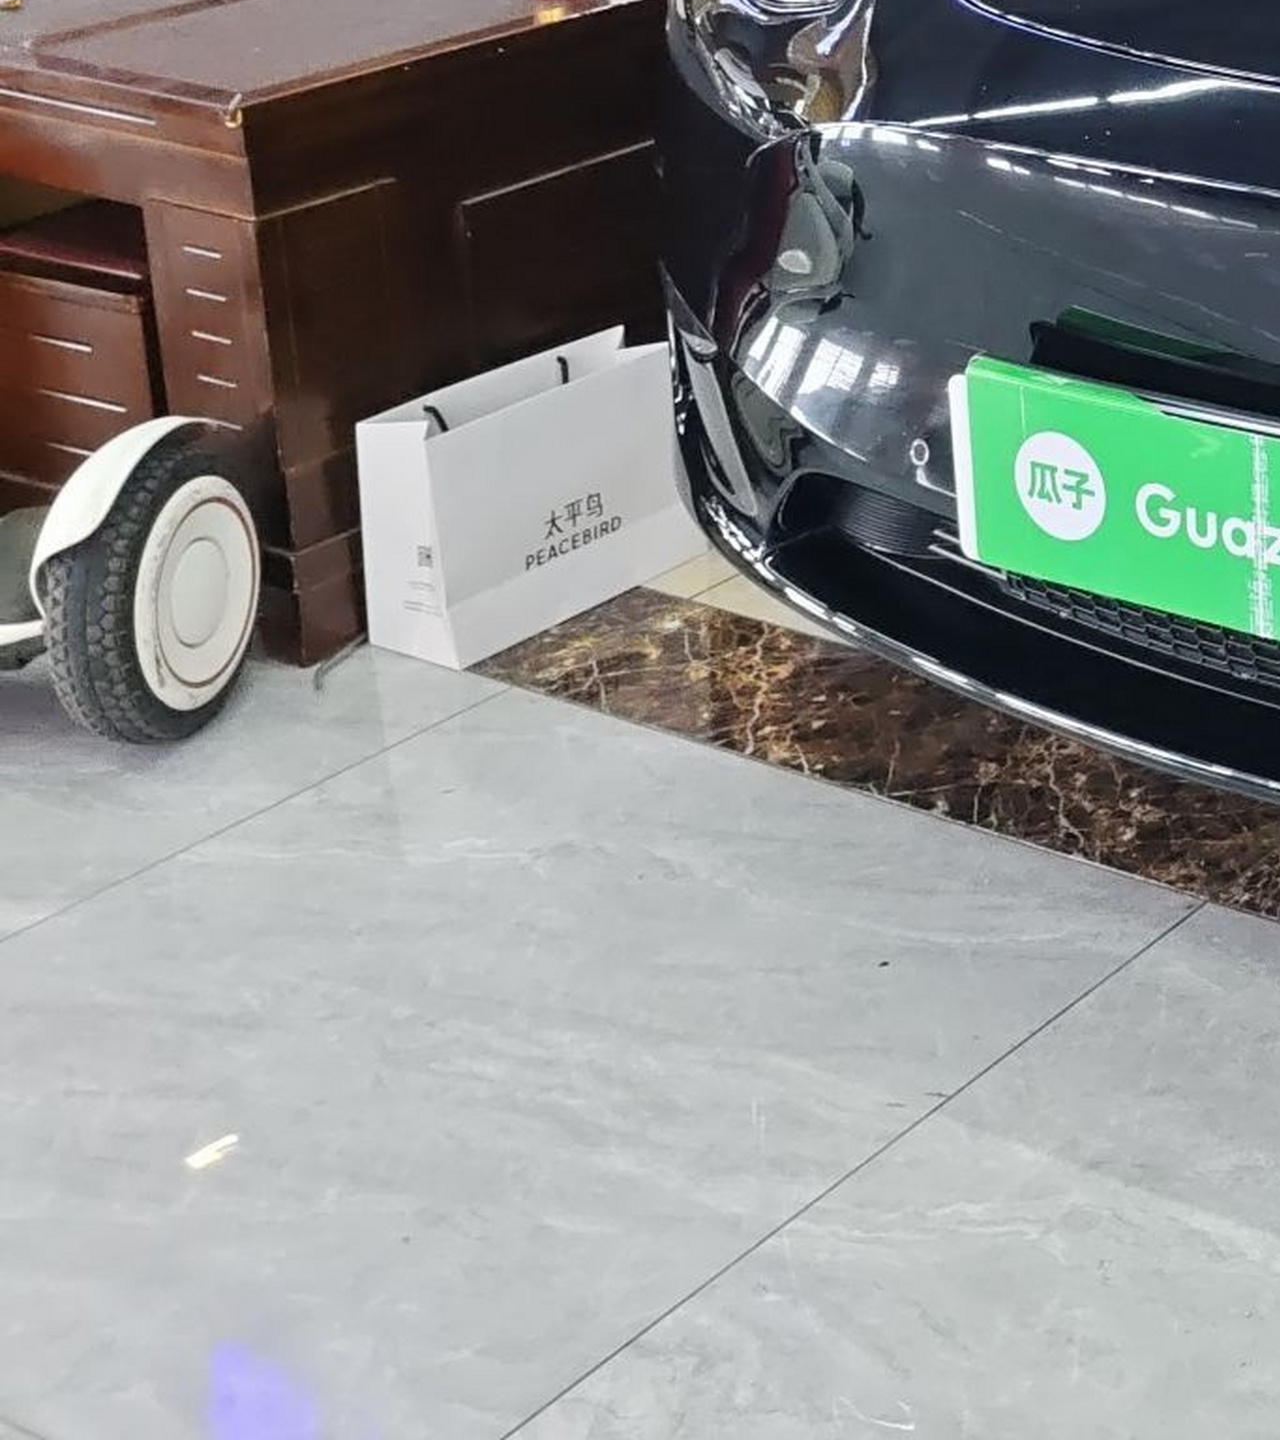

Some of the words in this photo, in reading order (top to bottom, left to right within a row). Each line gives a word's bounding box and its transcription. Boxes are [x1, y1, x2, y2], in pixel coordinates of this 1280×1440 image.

[1026, 461, 1096, 511] 瓜子
[543, 492, 603, 540] 太平鸟
[525, 515, 622, 571] PEACEBIRD
